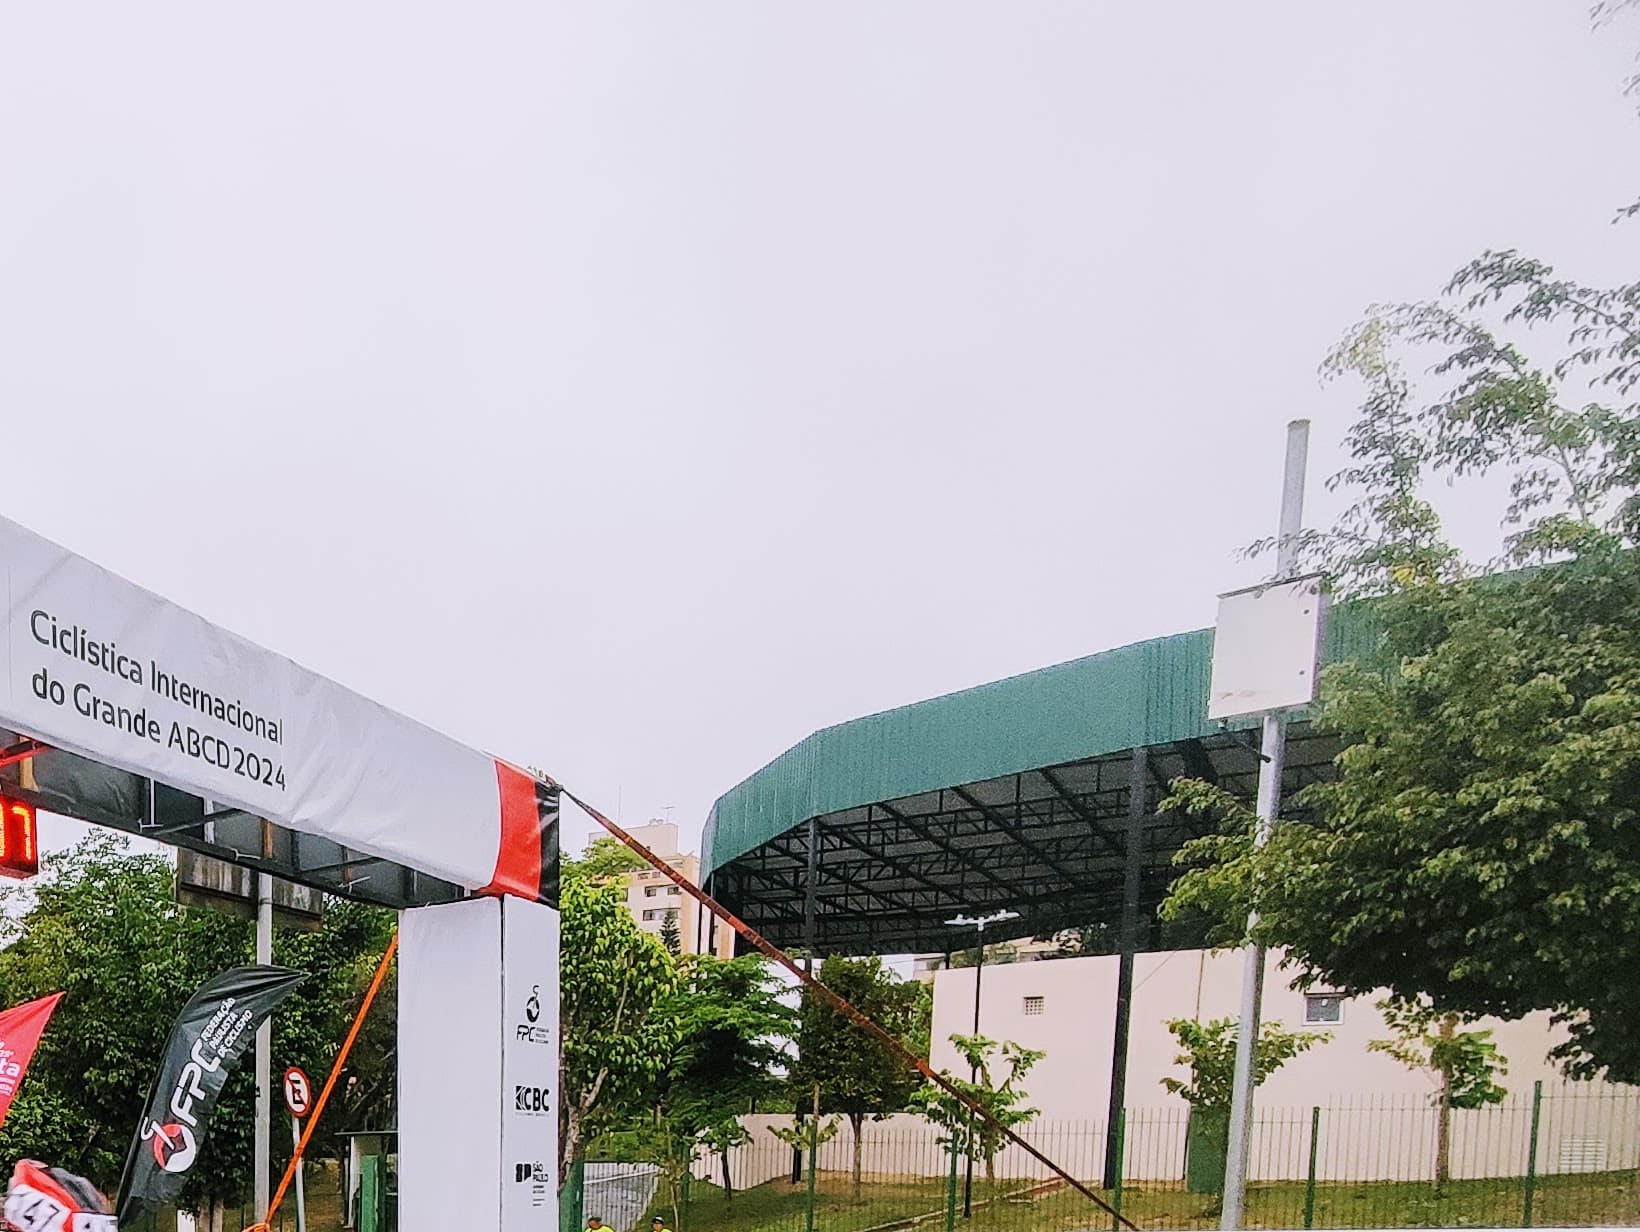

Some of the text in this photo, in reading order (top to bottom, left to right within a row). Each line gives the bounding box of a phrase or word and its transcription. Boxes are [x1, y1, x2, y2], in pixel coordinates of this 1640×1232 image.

[29, 609, 284, 745] Ciclística Internacional
[31, 667, 66, 706] do
[73, 683, 161, 744] Grande
[170, 1038, 222, 1128] FPC
[524, 1087, 550, 1112] CBC
